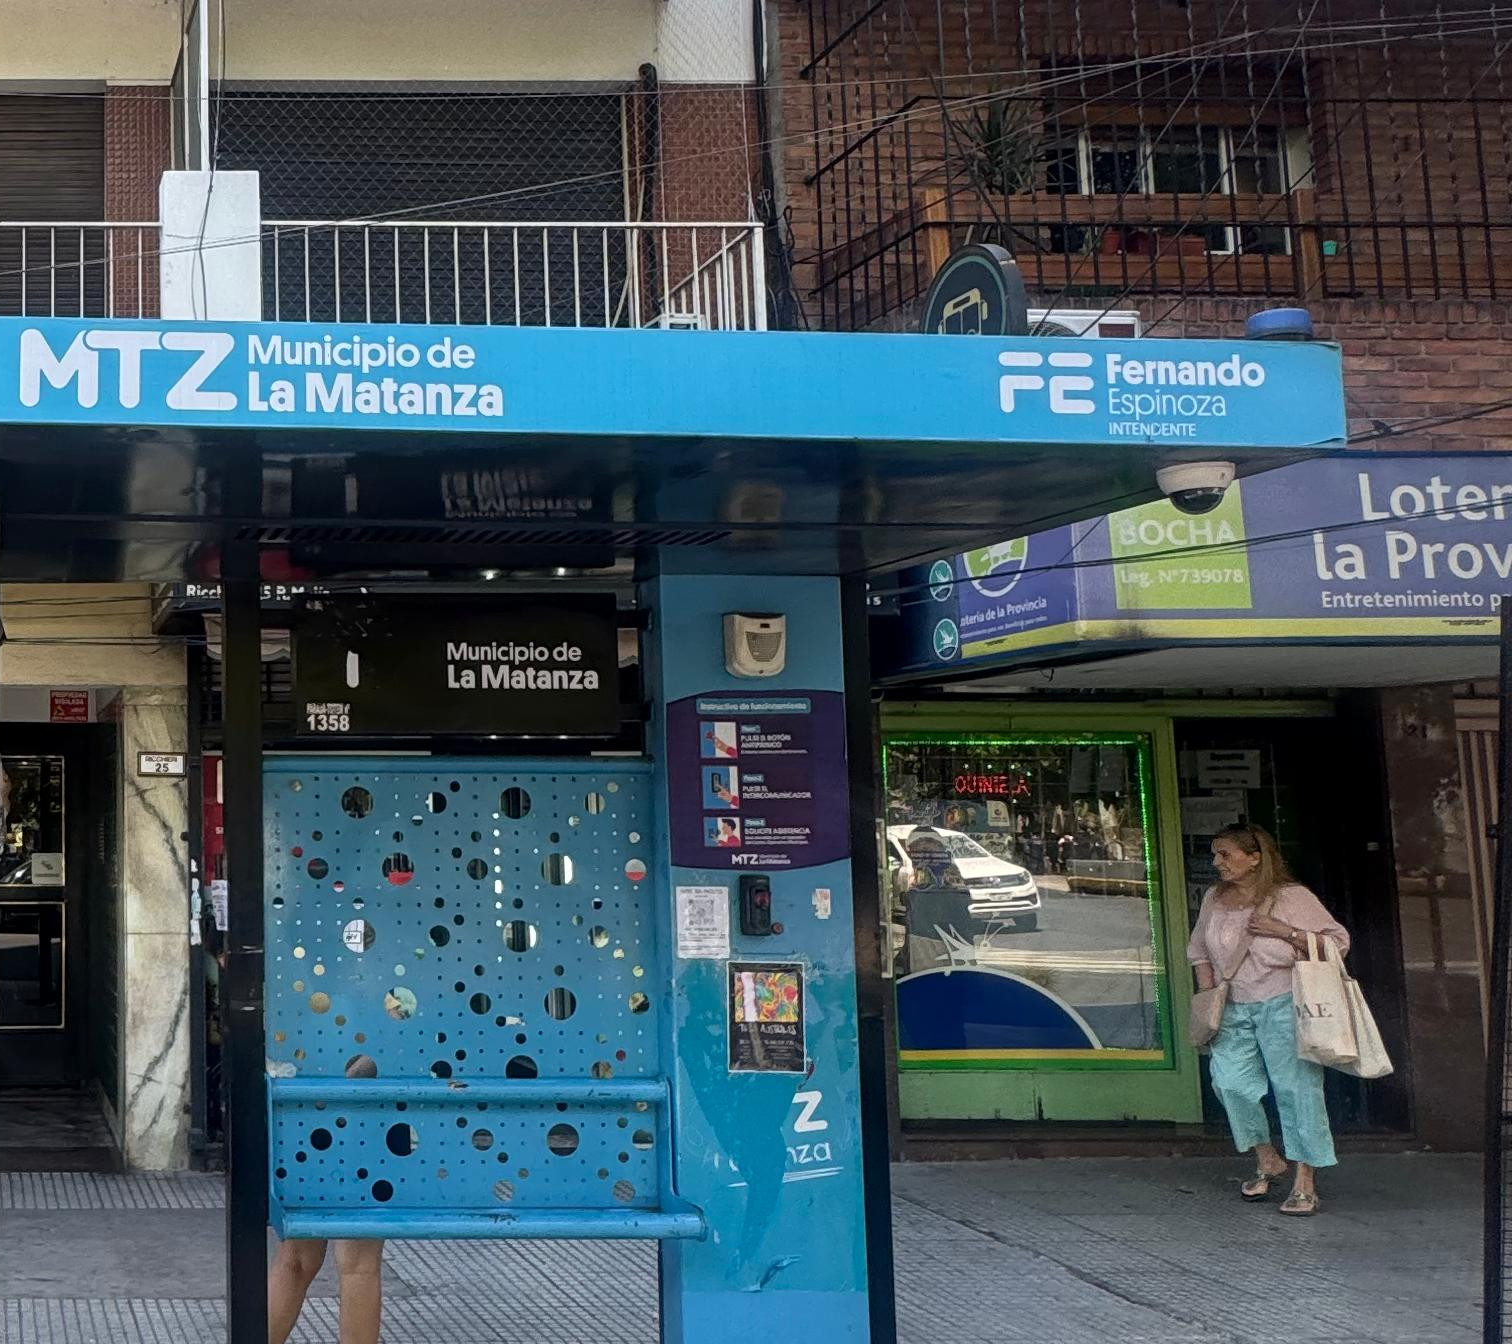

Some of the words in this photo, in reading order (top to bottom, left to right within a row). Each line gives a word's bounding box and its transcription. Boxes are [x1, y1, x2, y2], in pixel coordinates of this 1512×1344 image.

[248, 334, 420, 373] Municipio
[427, 337, 476, 369] de
[19, 328, 238, 411] MTZ
[1105, 353, 1266, 387] Fernando
[248, 372, 294, 413] La
[306, 373, 504, 417] Matanza
[1108, 388, 1227, 420] Espinoza
[1108, 422, 1197, 437] INTENDENTE
[1313, 530, 1368, 580] la
[1006, 596, 1048, 616] Provincia
[1321, 589, 1484, 609] Entretenimiento
[446, 642, 549, 665] Municipio
[552, 642, 582, 661] de
[448, 665, 476, 689] La
[482, 665, 599, 690] Matanza
[307, 714, 350, 732] 1358
[155, 763, 169, 773] 25
[731, 854, 759, 865] MTZ
